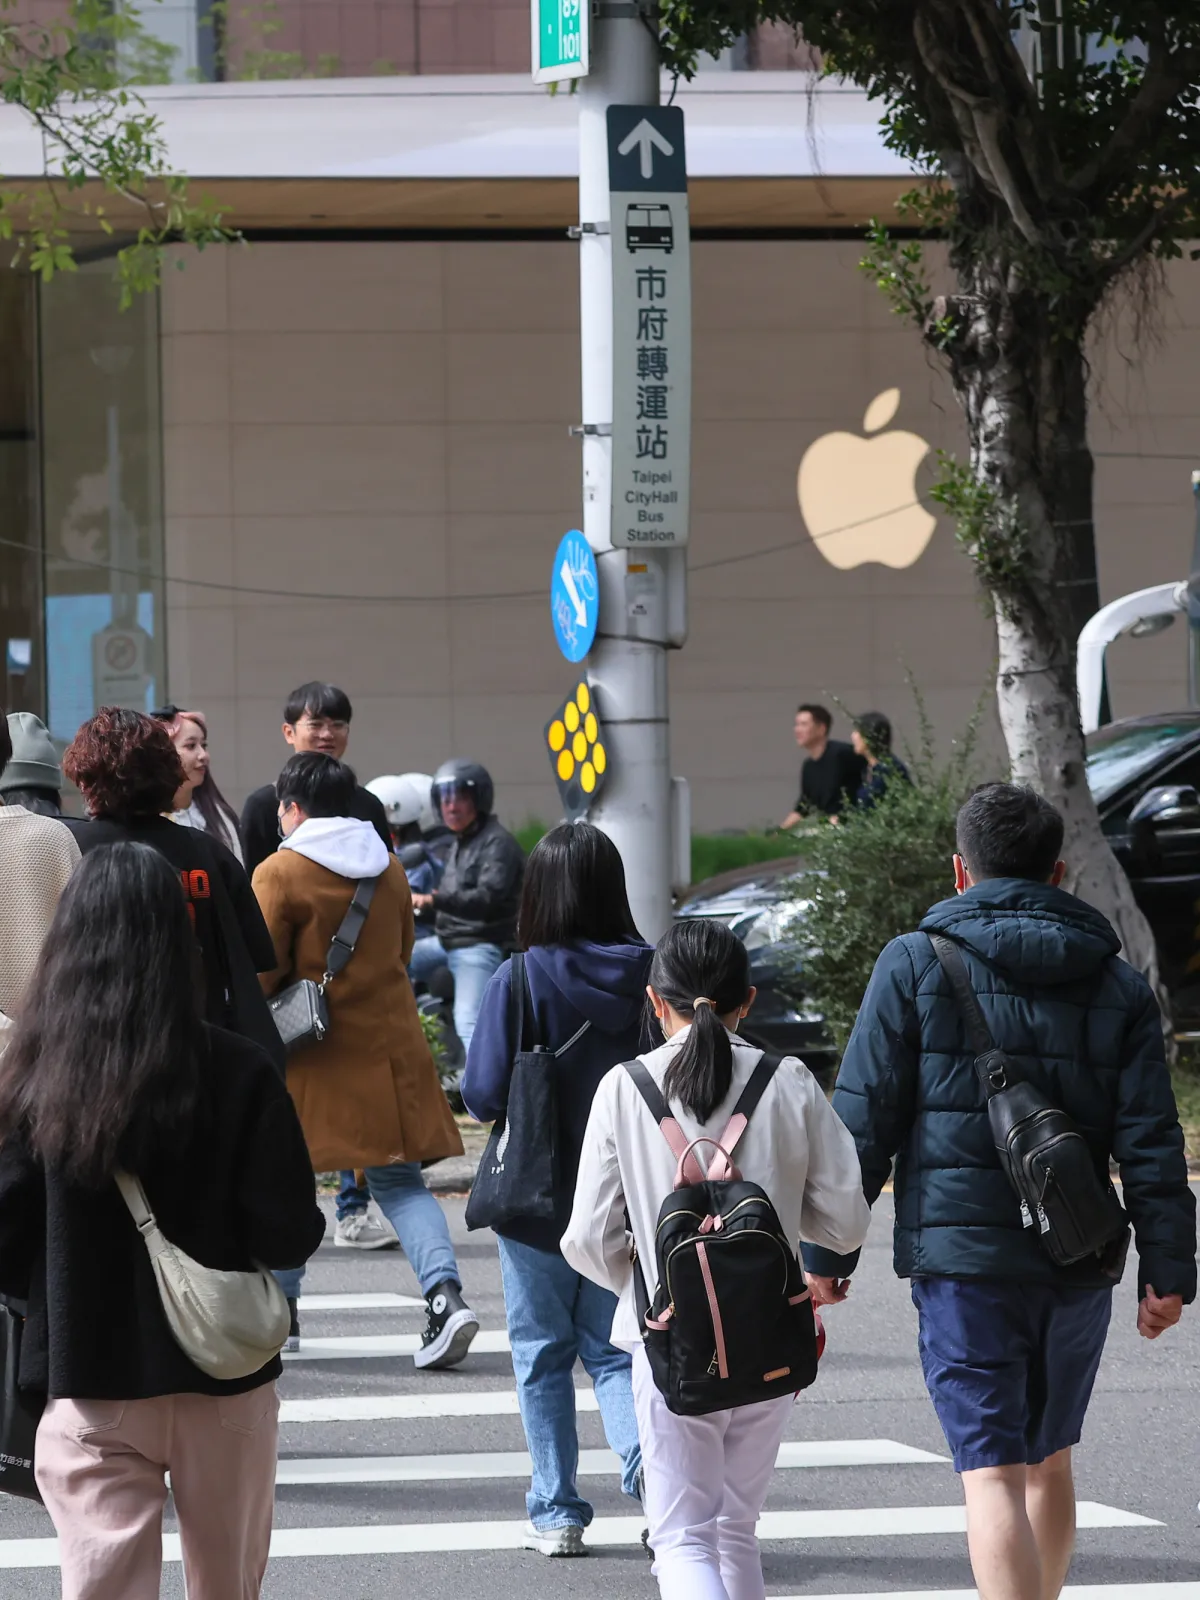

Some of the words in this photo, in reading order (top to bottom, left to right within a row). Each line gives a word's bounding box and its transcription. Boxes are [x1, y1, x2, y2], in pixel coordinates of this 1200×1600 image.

[635, 265, 668, 460] 市府轉運站
[632, 469, 672, 485] Taipei
[624, 490, 678, 506] CityHall
[637, 509, 664, 523] Bus
[626, 528, 675, 541] Station
